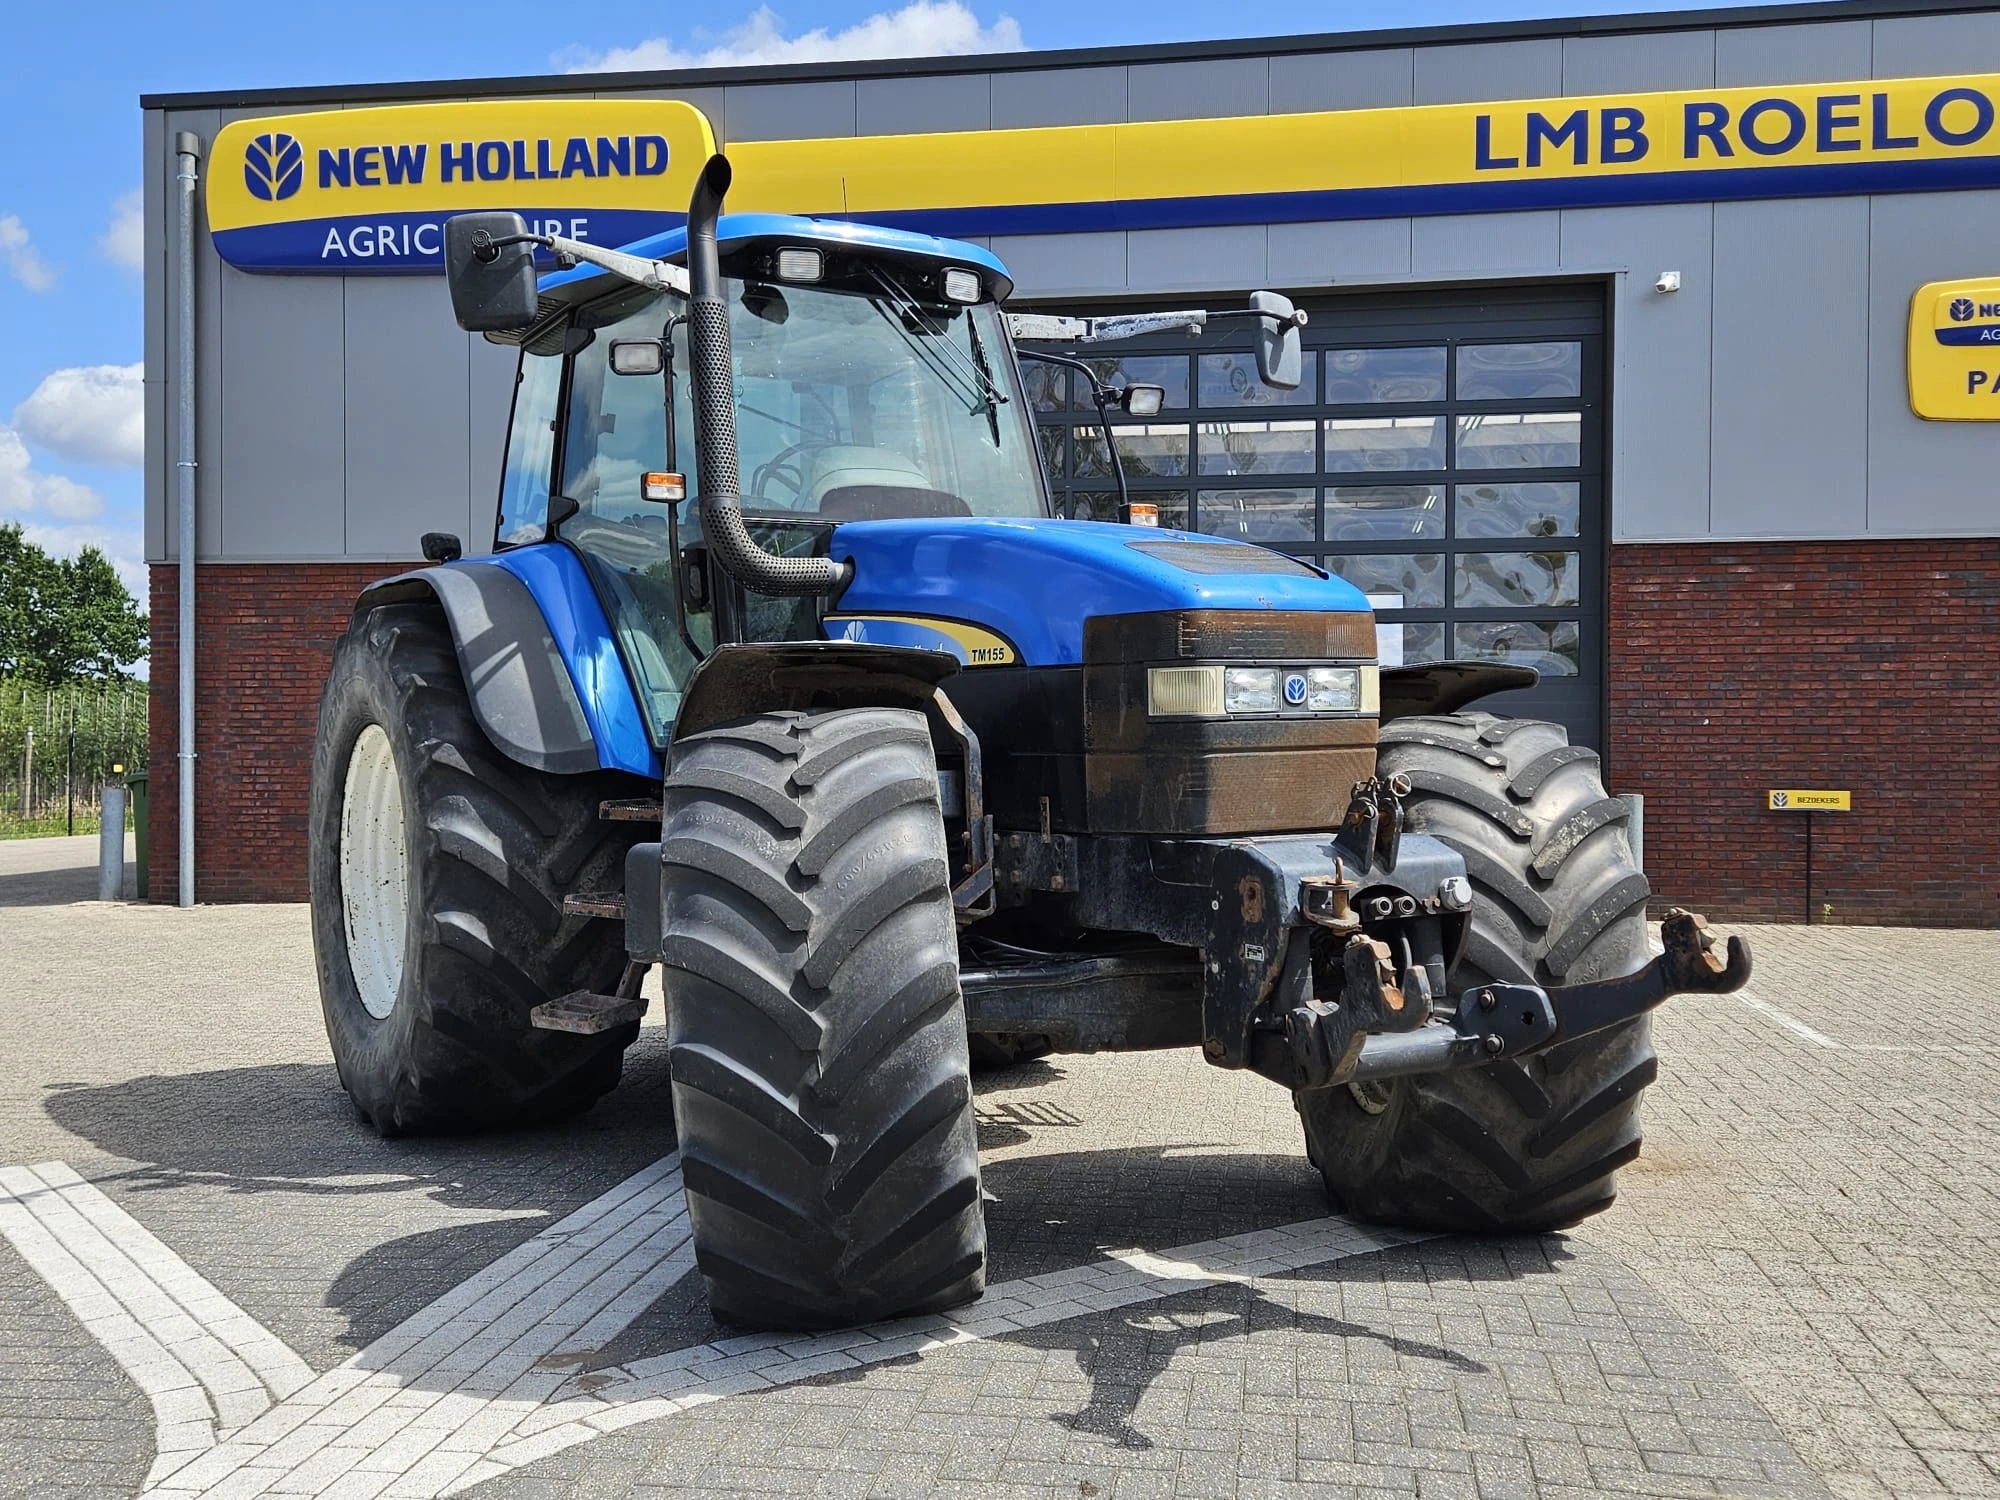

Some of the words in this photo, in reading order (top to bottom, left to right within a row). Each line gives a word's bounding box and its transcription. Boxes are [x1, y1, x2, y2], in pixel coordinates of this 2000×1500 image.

[1475, 107, 1649, 170] LMB
[1683, 88, 1995, 159] ROELO
[319, 144, 427, 188] NEW
[440, 135, 669, 182] HOLLAND
[321, 218, 588, 258] AGRICRE
[972, 648, 1005, 662] TM155
